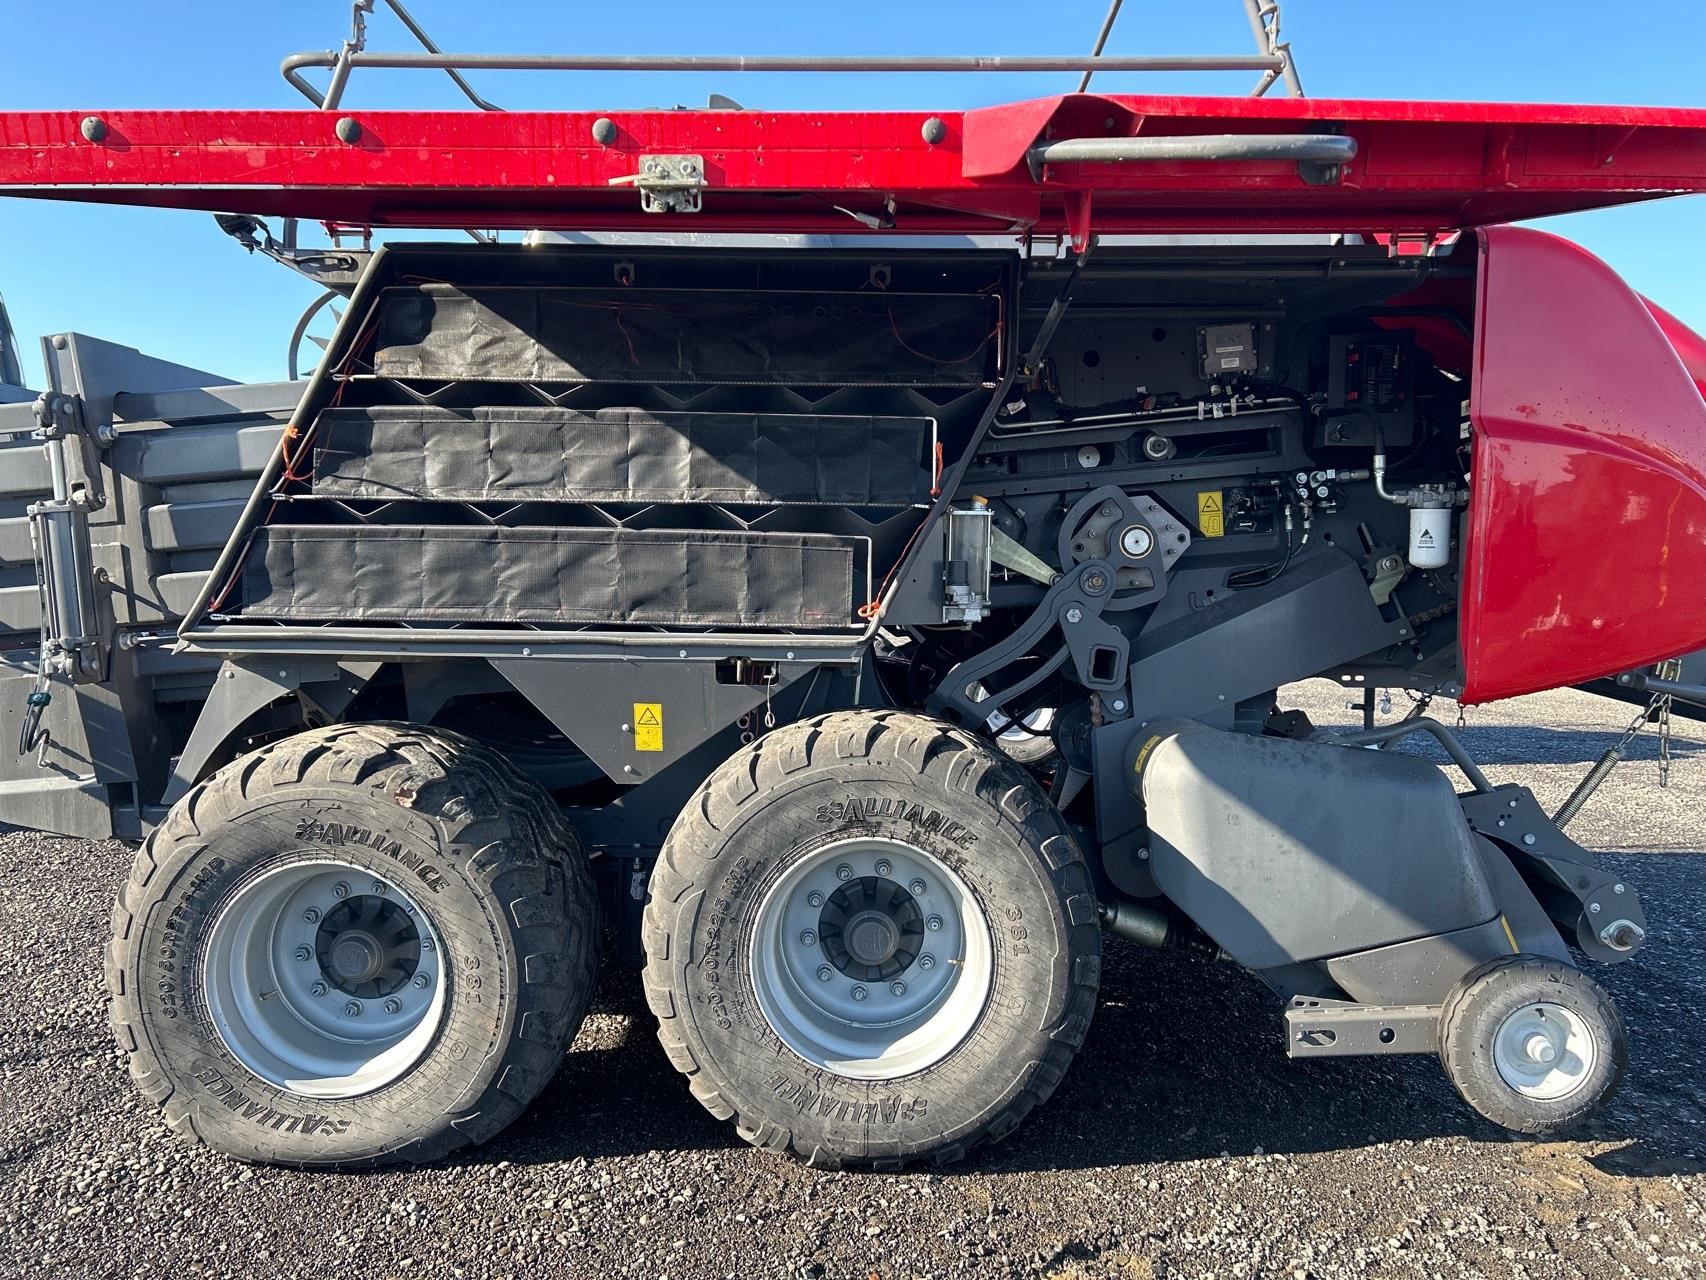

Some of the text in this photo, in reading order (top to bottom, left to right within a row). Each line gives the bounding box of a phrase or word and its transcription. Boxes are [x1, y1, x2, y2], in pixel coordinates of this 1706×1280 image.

[842, 797, 978, 850] ALLIANCE
[321, 822, 449, 894] ALLIANCE
[1005, 906, 1031, 957] 381
[463, 955, 481, 1005] 381
[195, 1066, 328, 1136] ALLIANCE
[764, 1070, 902, 1126] ALLIANCE
